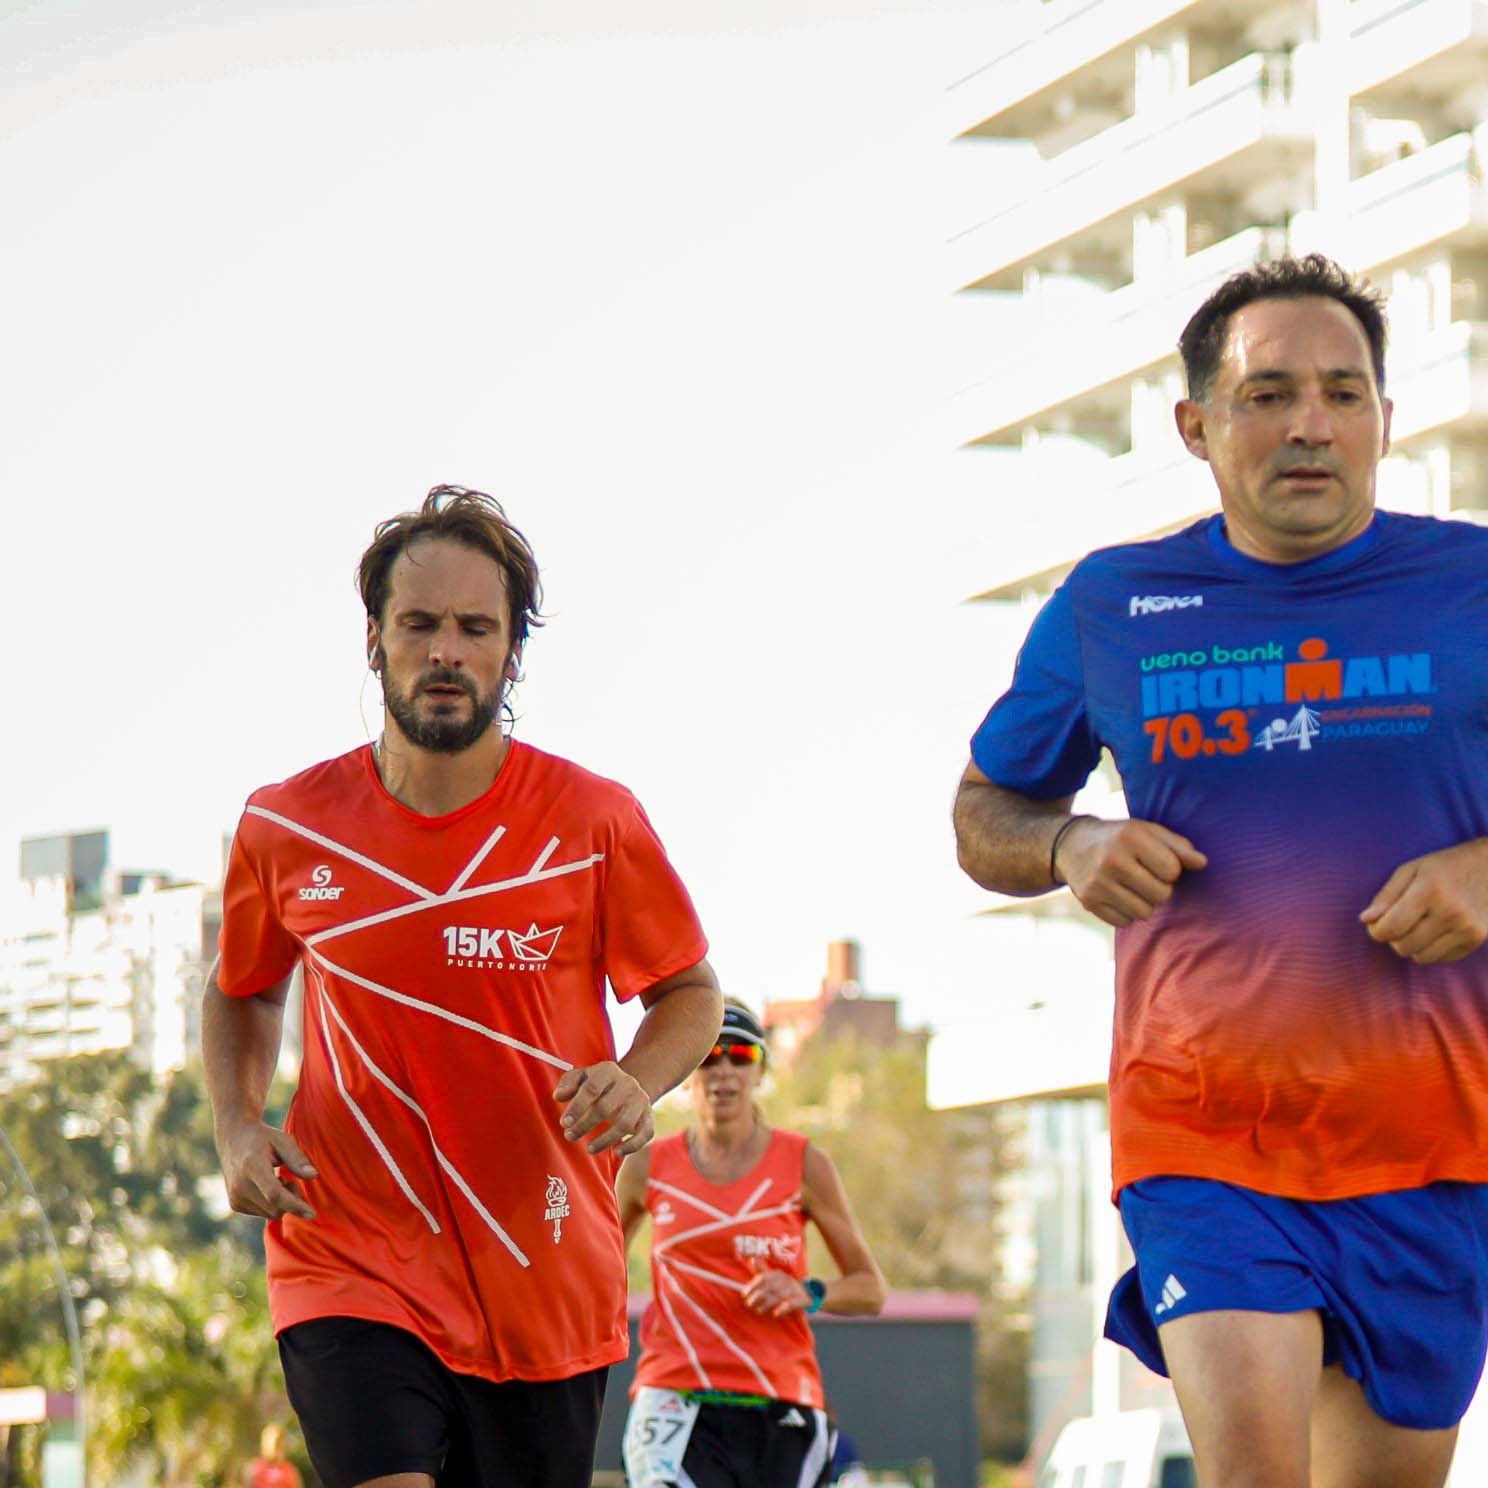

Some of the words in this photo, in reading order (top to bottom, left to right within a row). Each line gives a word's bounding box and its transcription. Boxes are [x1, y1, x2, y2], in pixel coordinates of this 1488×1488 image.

[1140, 650, 1207, 672] ueno
[1211, 641, 1284, 665] bank
[1142, 639, 1431, 717] IRONMAN
[1144, 708, 1252, 764] 70.3
[1321, 720, 1430, 741] PARAGUAY
[443, 926, 504, 960] 15K
[544, 1204, 570, 1221] ARDEC
[635, 1417, 686, 1446] 57
